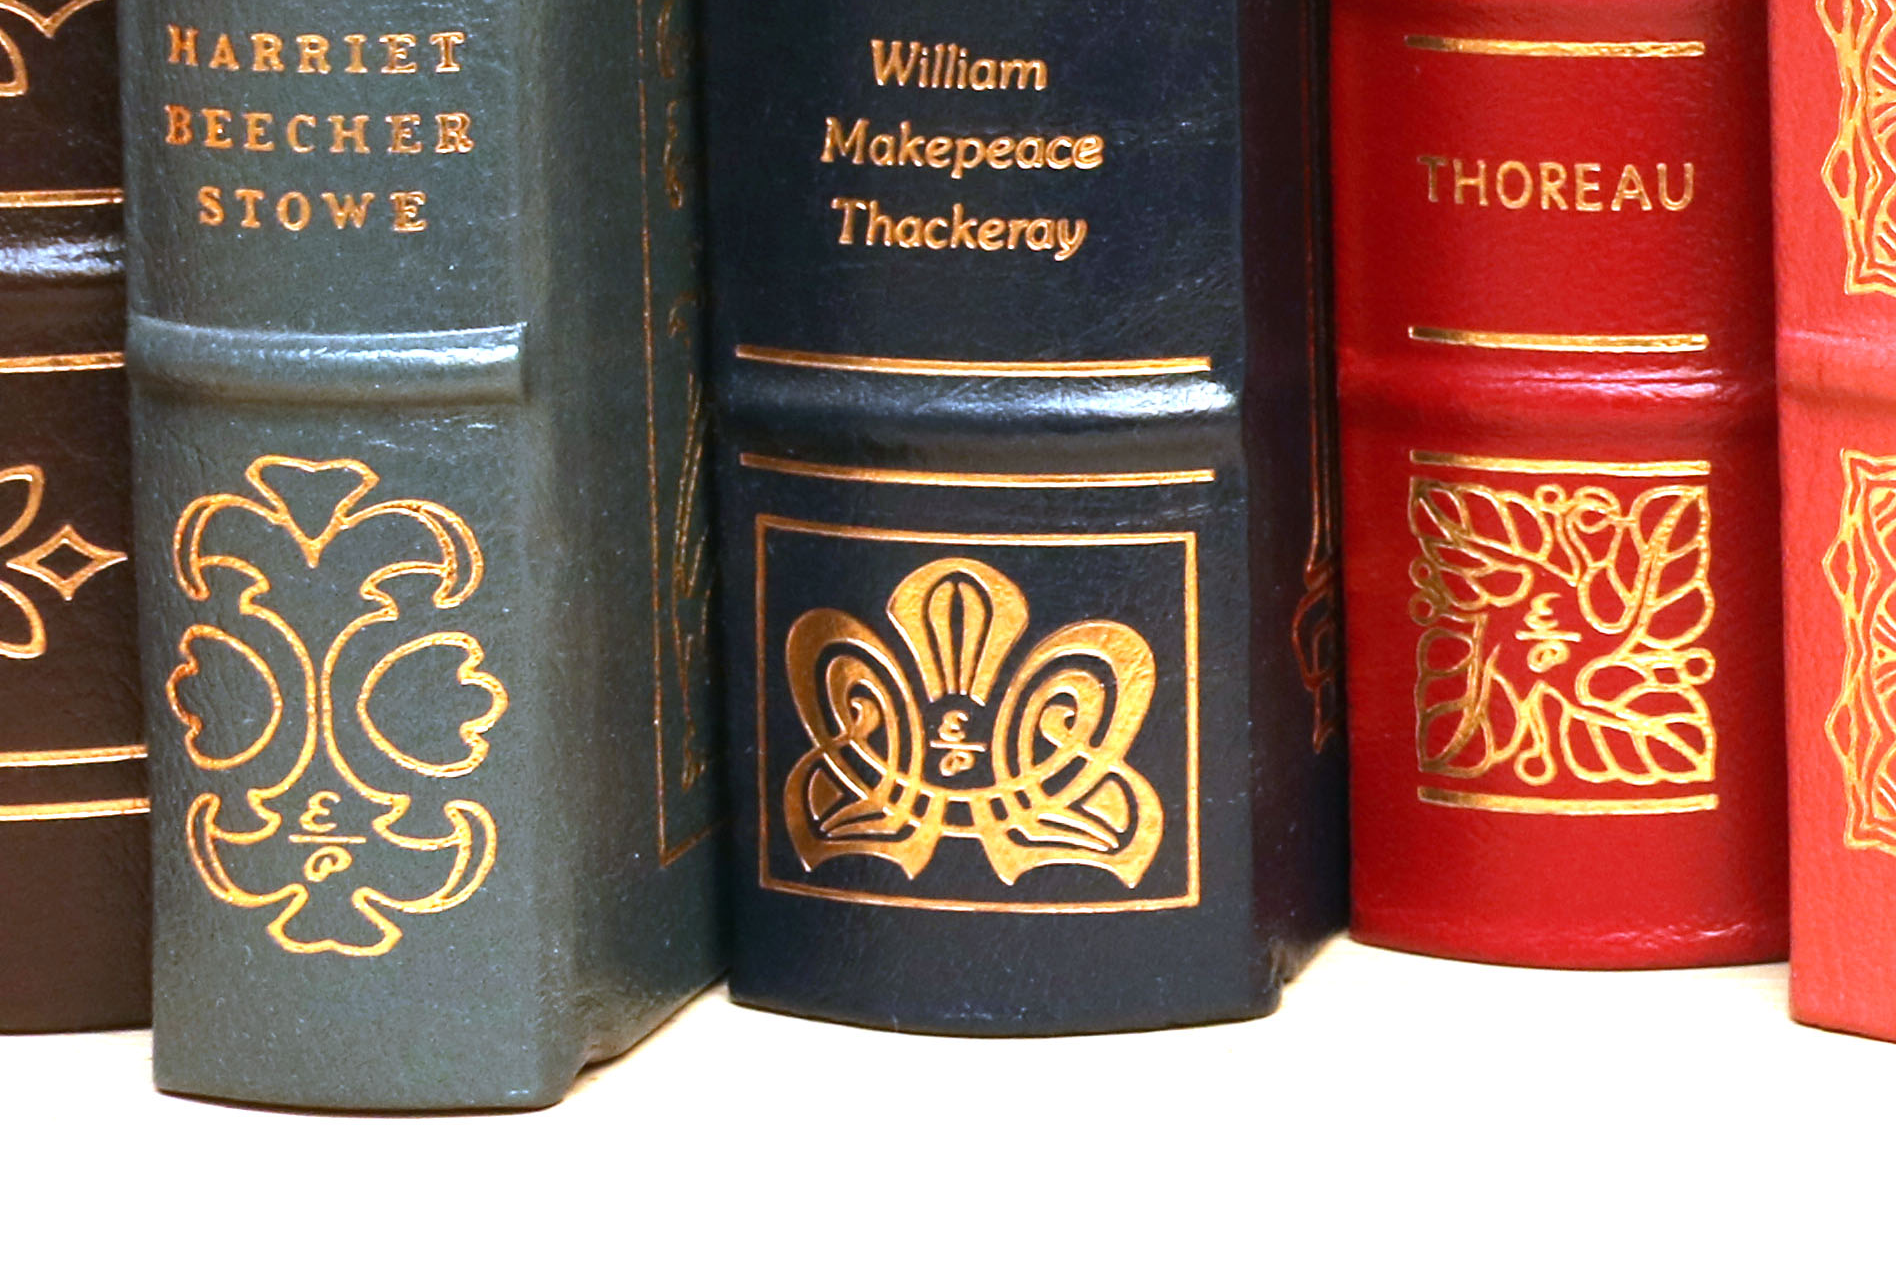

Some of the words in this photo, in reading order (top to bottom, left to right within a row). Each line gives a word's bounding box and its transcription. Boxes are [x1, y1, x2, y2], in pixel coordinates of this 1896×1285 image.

[165, 24, 467, 76] HARRIET
[870, 38, 1050, 91] William
[163, 104, 475, 156] BEECHER
[820, 116, 1105, 180] Makepeace
[197, 184, 427, 233] STOWE
[1417, 155, 1695, 212] THOREAU
[830, 197, 1089, 262] Thackeray
